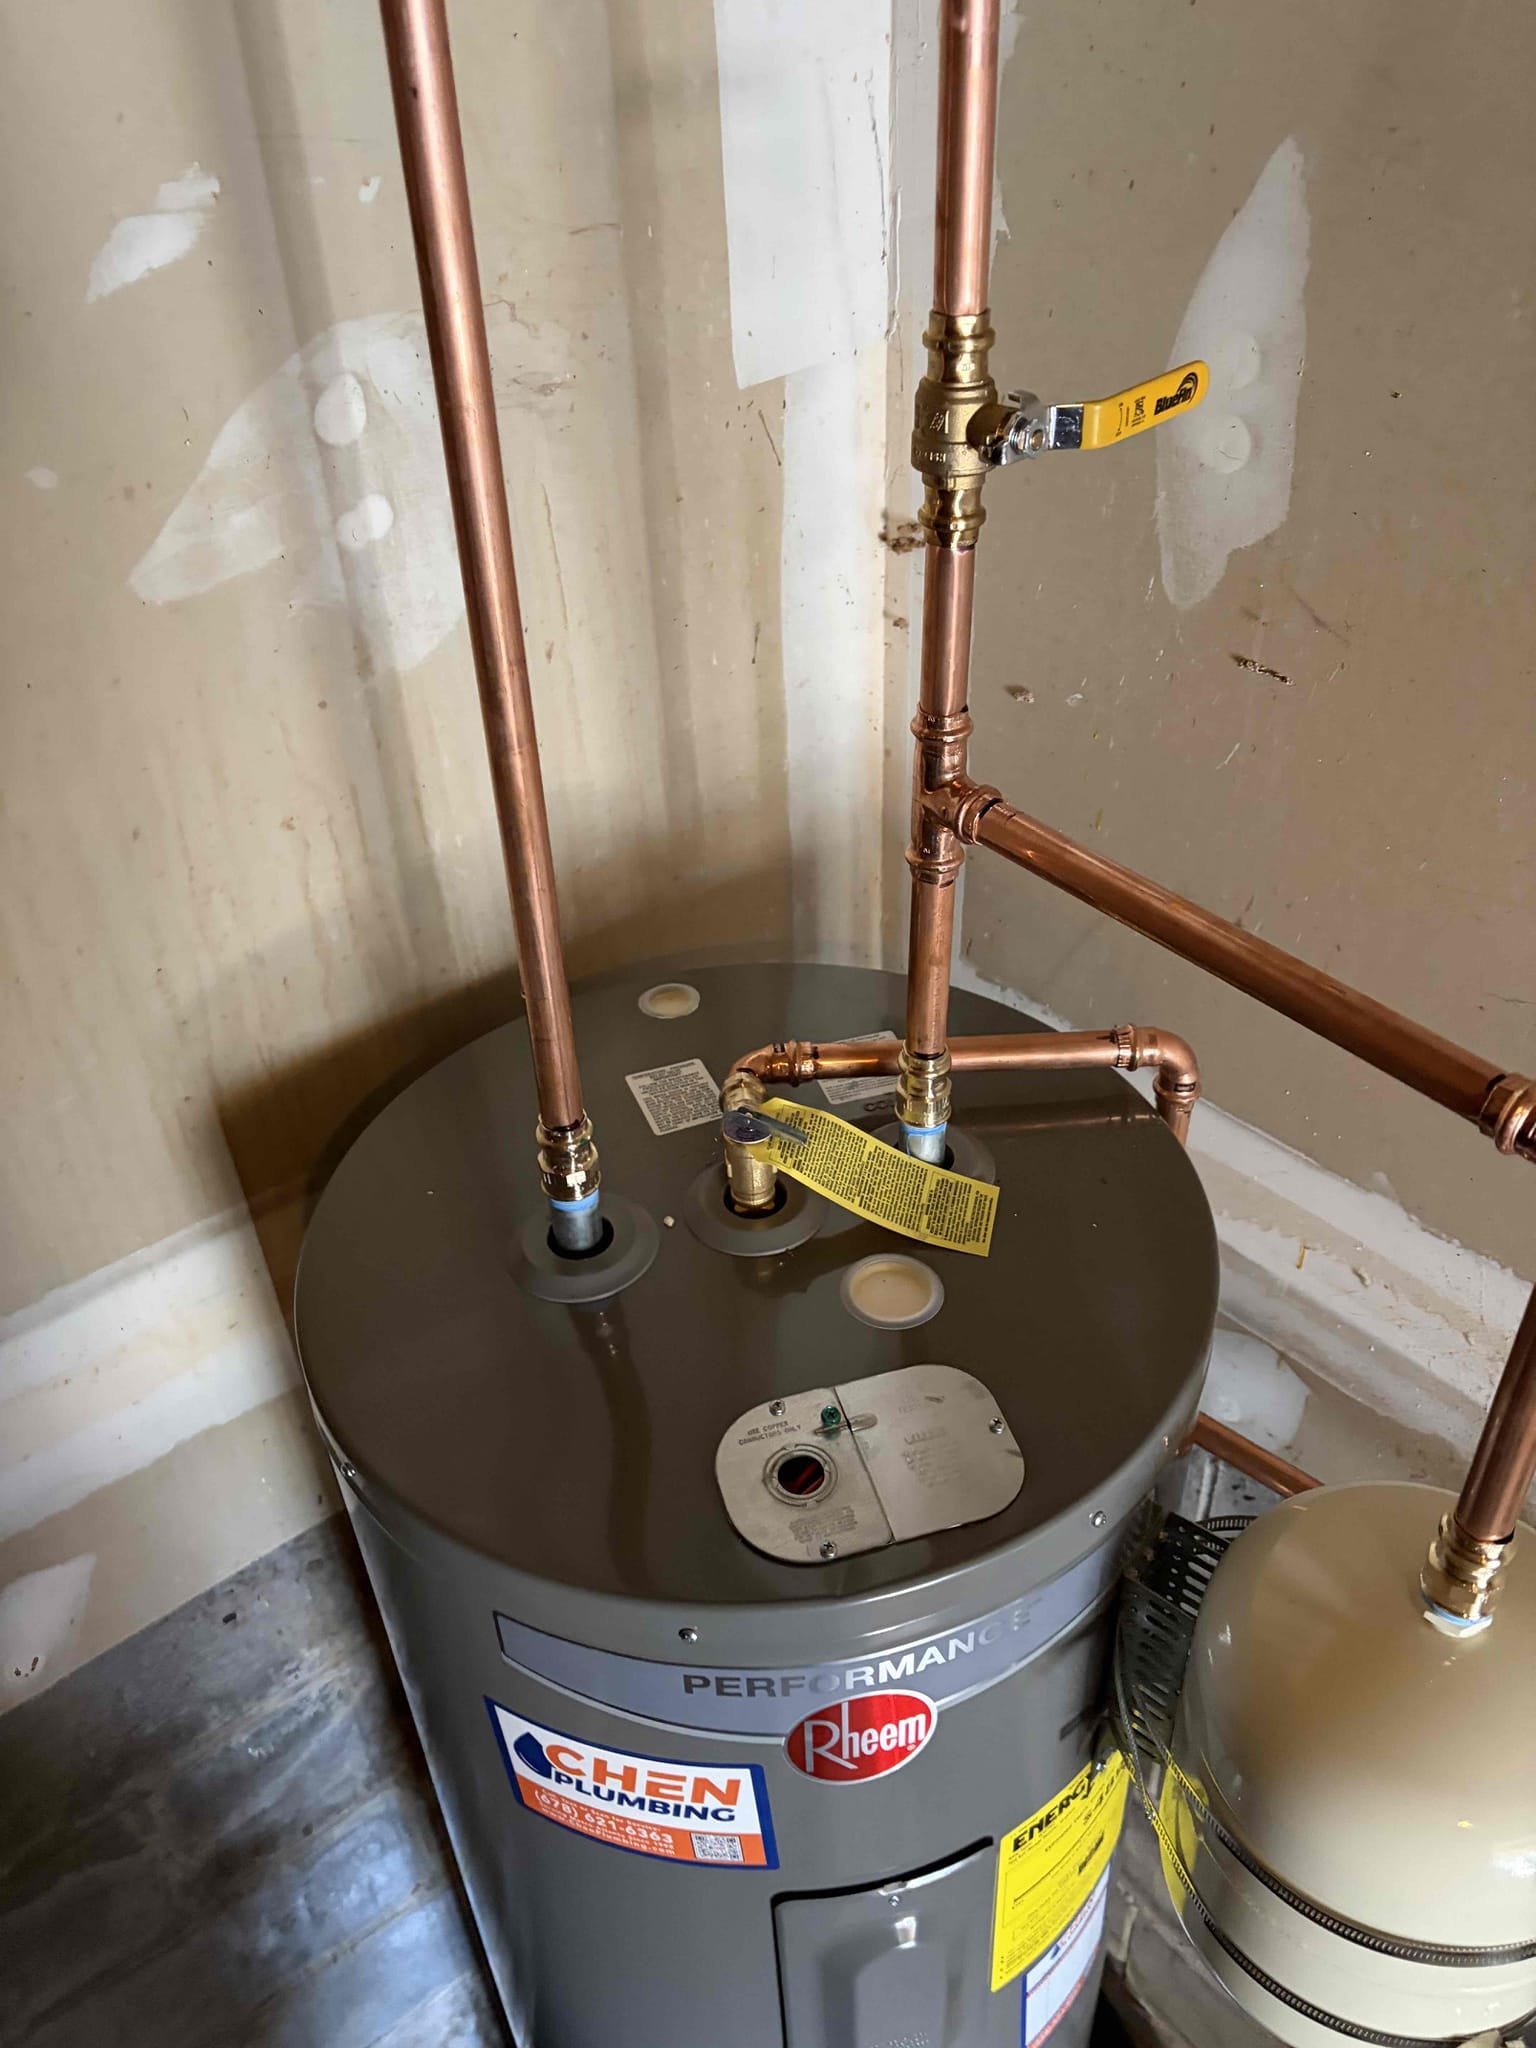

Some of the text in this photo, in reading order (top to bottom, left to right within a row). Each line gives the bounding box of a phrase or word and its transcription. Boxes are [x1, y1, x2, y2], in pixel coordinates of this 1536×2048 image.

[738, 1429, 782, 1446] CONDUCTORS
[747, 1420, 789, 1437] USE COPPER
[803, 1701, 927, 1774] Rheem
[545, 1744, 742, 1806] CHEN
[551, 1768, 736, 1822] PLUMBING
[534, 1789, 578, 1818] (678)
[584, 1812, 674, 1844] 621-6363
